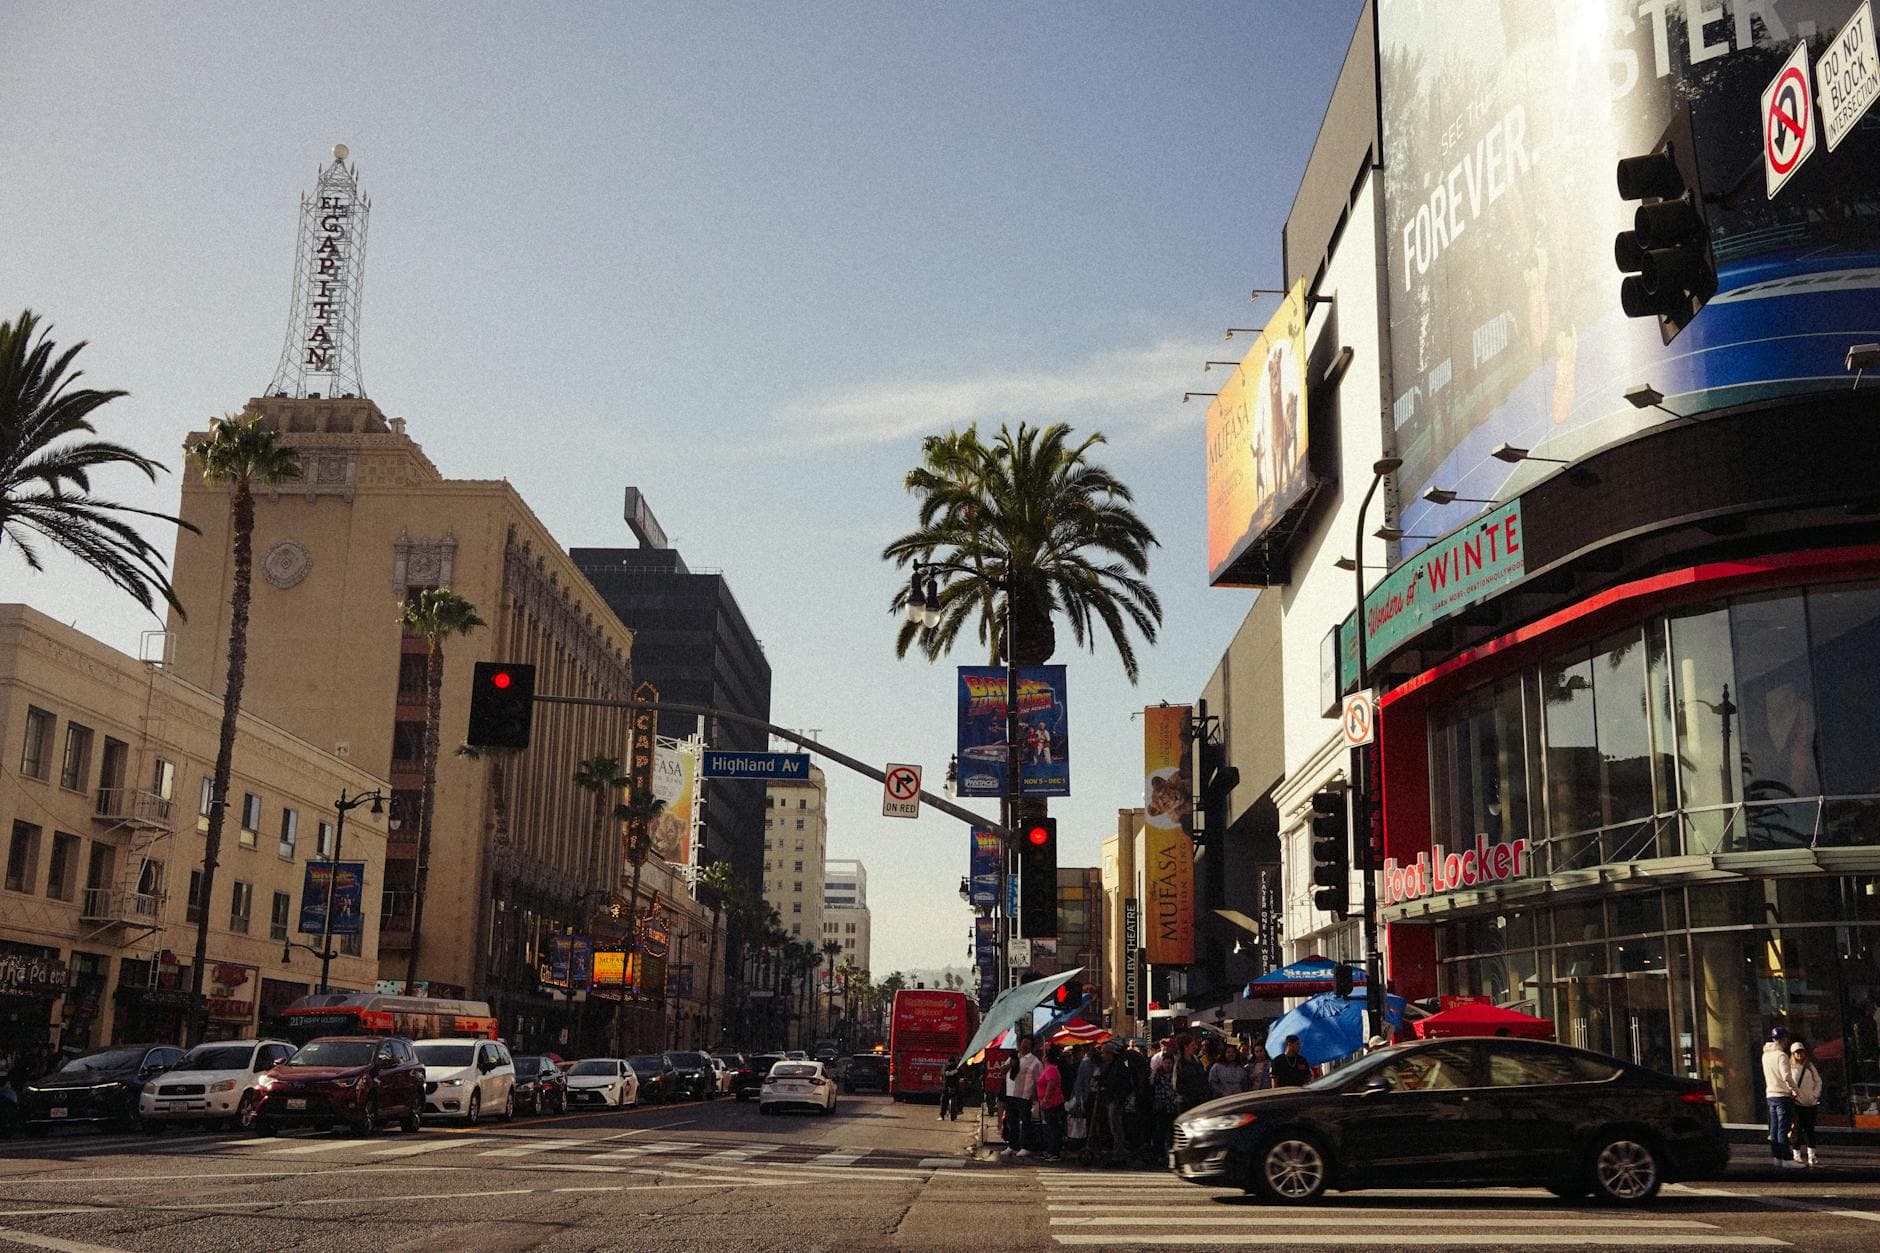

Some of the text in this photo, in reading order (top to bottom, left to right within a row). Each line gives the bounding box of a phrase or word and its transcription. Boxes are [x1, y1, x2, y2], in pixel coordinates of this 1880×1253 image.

[1824, 17, 1865, 86] DO NOT
[1831, 52, 1868, 111] BLOCK
[1441, 113, 1464, 157] SEE
[1828, 71, 1879, 140] INTERSECTION
[306, 216, 339, 364] CAPITAN
[1209, 401, 1250, 464] MUFASA
[1426, 513, 1520, 593] WINTE
[1368, 592, 1404, 639] Wonders
[712, 756, 799, 775] Highland Av
[886, 803, 916, 814] ON RED
[1160, 844, 1178, 942] MUFASA
[1384, 833, 1531, 904] Foot Locker
[1127, 904, 1136, 992] DOLBY THEATRE
[290, 1016, 304, 1026] 217
